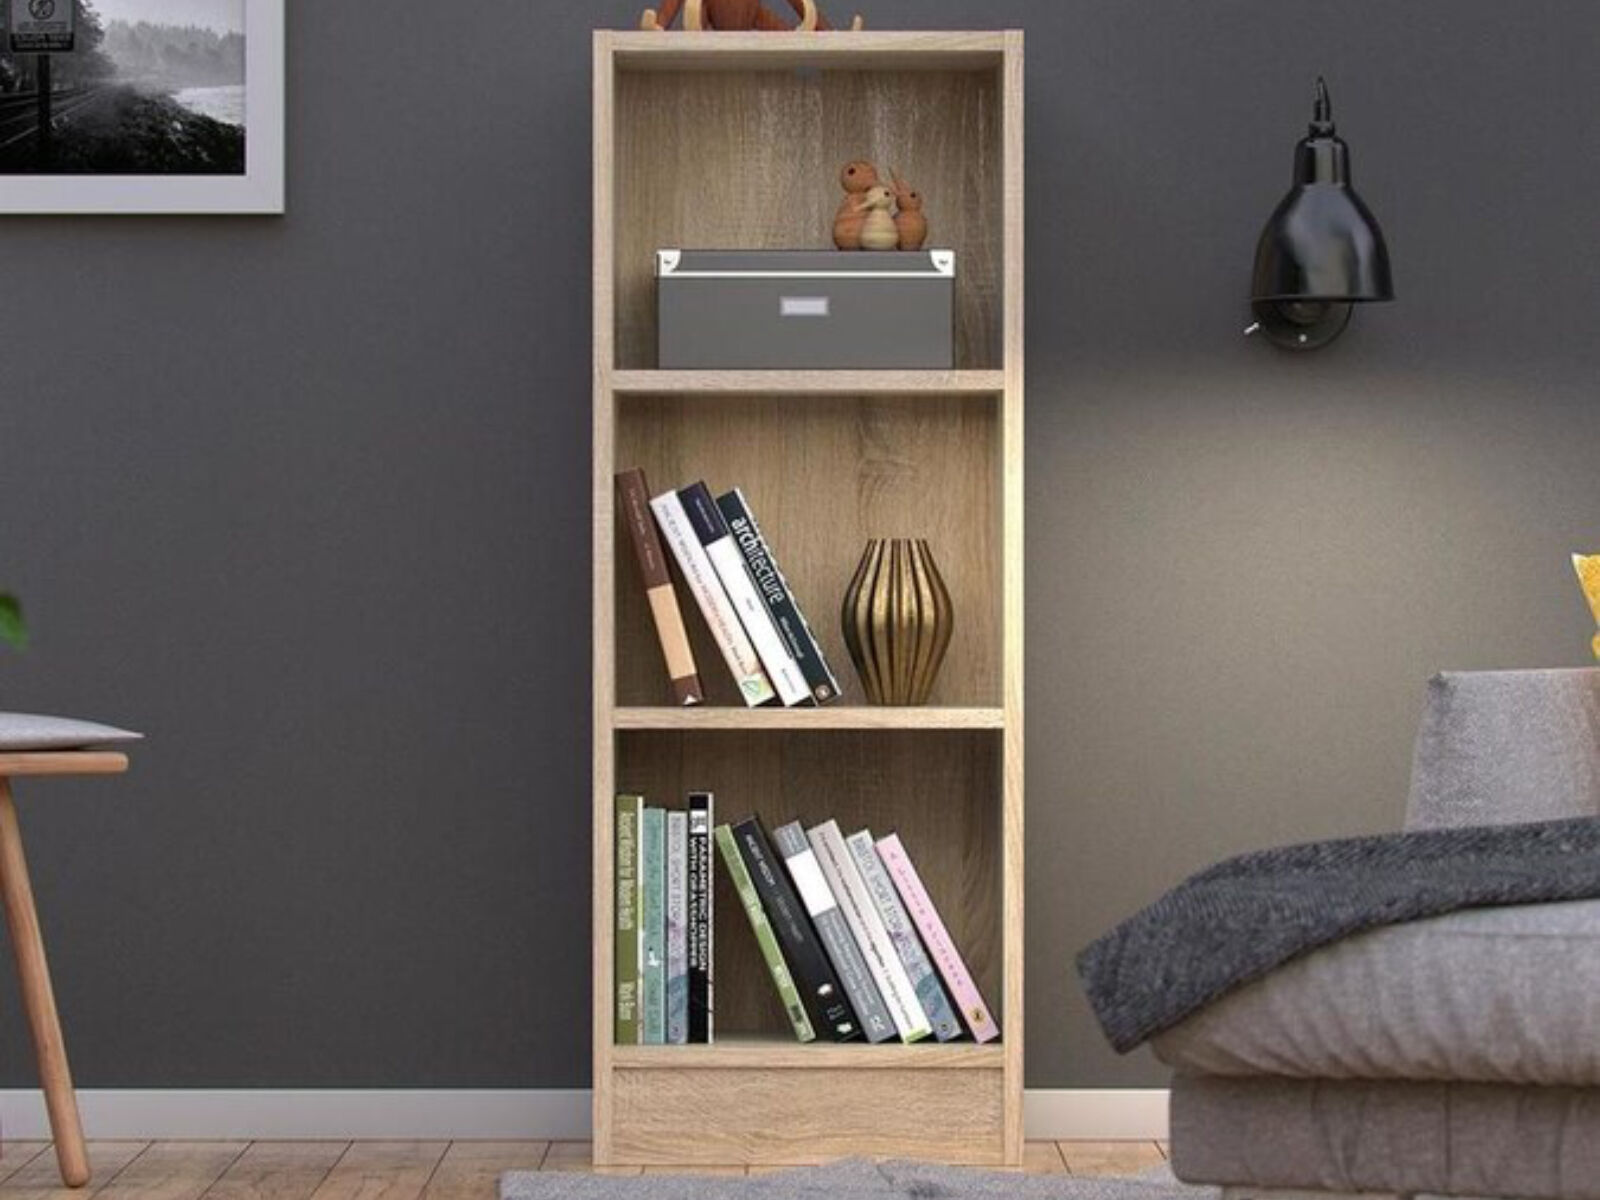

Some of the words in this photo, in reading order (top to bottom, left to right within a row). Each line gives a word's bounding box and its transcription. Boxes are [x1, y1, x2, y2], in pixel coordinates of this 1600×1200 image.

[731, 516, 785, 604] architecture
[689, 838, 697, 869] WITH
[698, 836, 706, 920] PARAMETRIC
[698, 922, 706, 970] DESIGN
